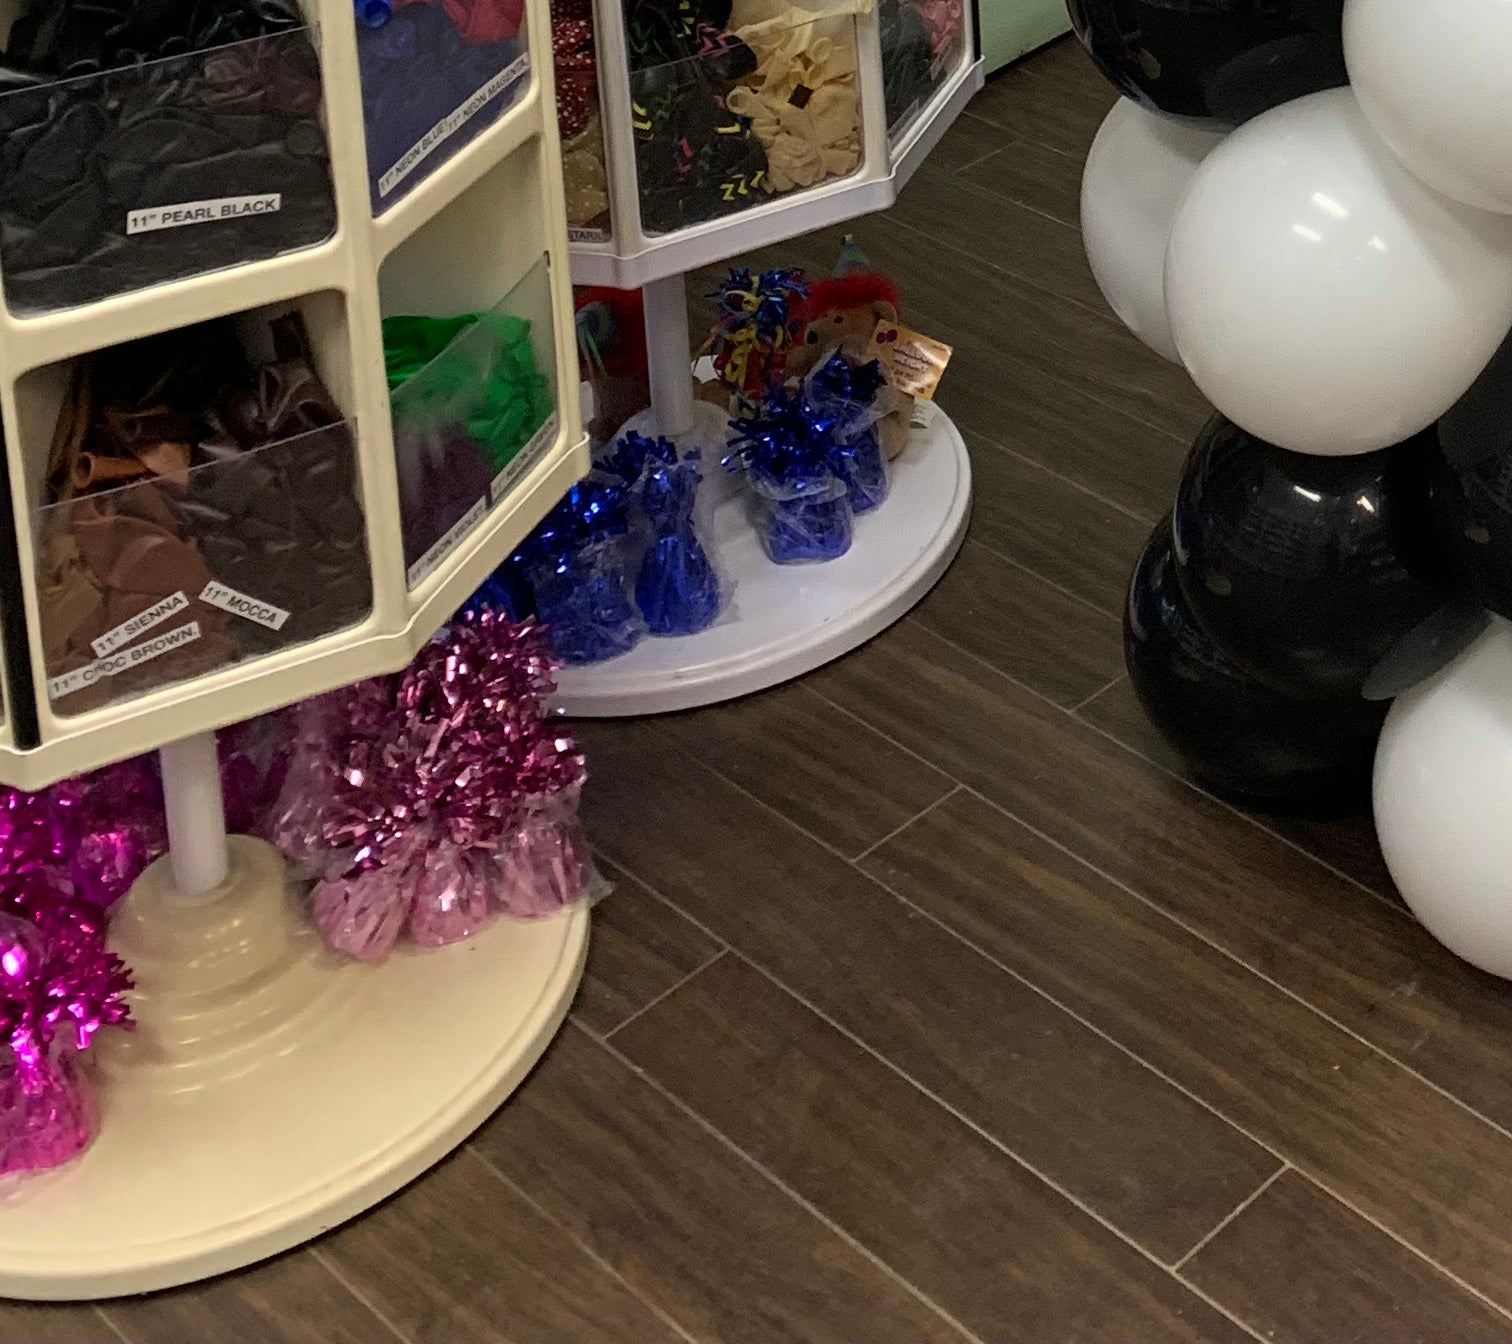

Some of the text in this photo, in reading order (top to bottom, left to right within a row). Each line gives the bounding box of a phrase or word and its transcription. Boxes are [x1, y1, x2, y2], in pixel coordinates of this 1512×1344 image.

[131, 198, 277, 229] 11" PEARL BLACK
[123, 596, 183, 636] SIENNA
[227, 594, 277, 626] MOCCA
